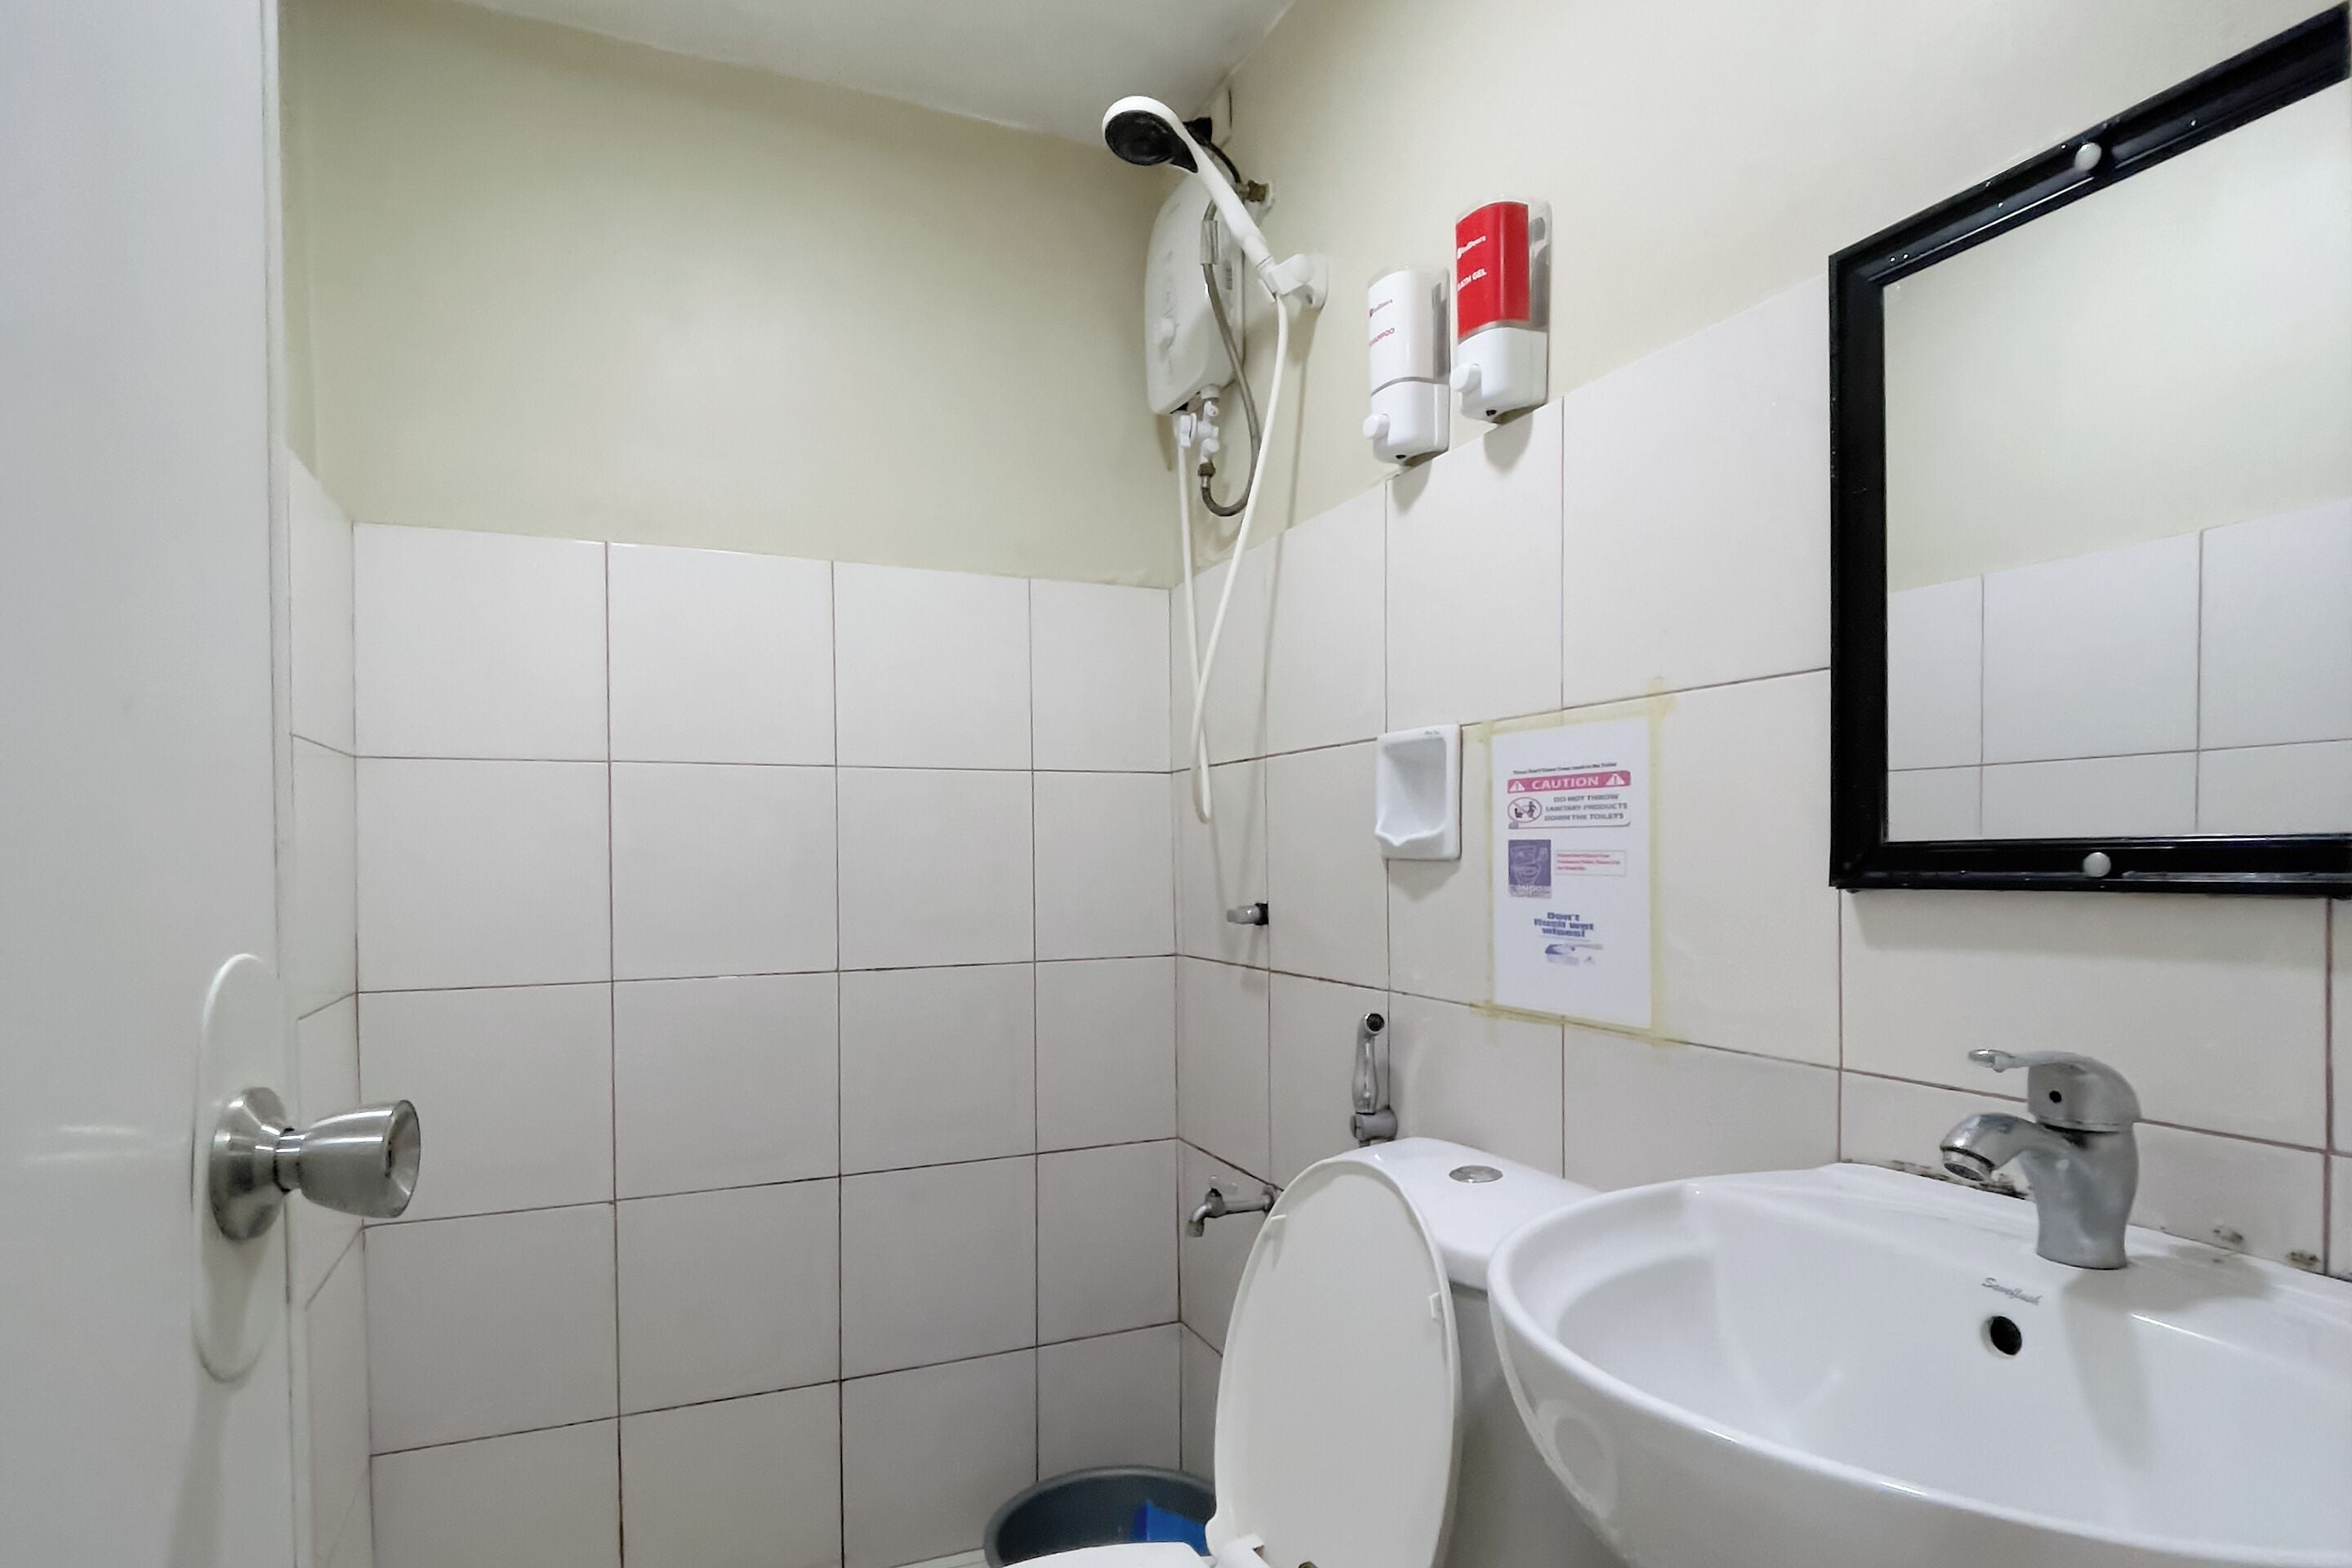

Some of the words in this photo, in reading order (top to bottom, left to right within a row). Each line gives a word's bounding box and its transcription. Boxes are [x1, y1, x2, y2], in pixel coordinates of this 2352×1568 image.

[1472, 268, 1488, 281] GEL
[1531, 777, 1599, 790] CAUTION
[1547, 912, 1580, 921] Don't
